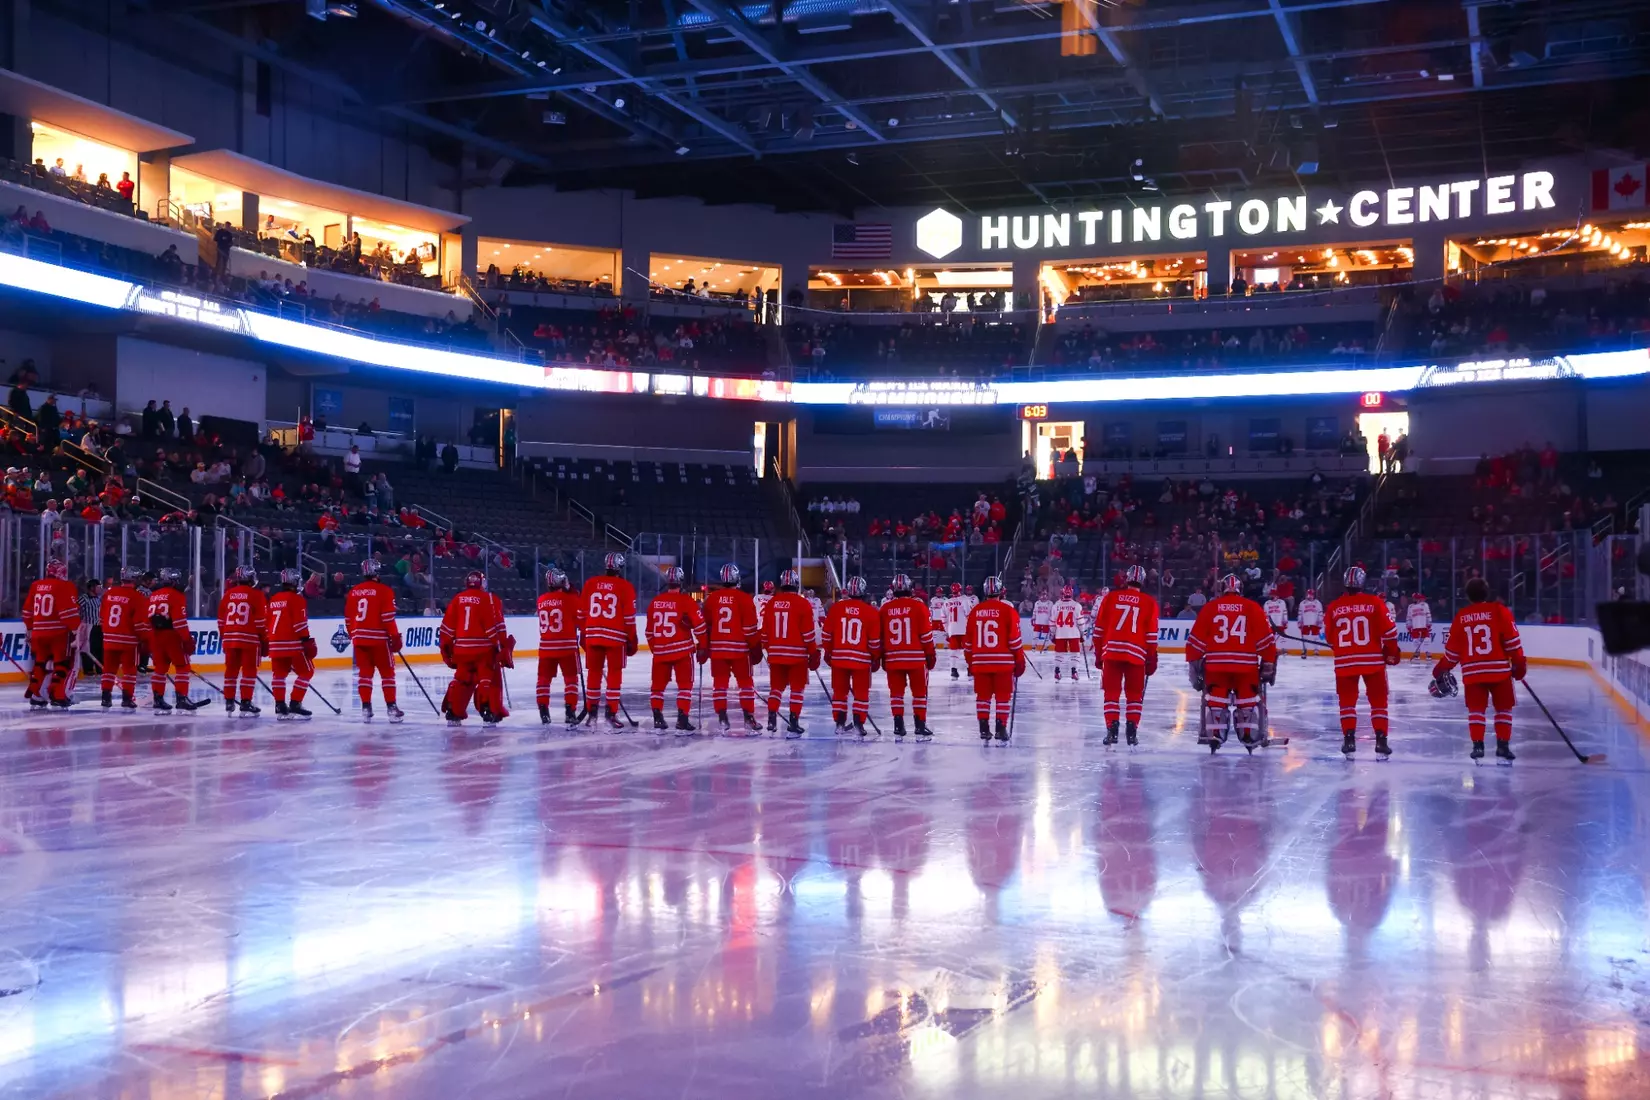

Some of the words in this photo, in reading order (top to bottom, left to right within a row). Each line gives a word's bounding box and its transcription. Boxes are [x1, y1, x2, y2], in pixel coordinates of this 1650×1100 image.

[982, 196, 1306, 249] HUNTINGTON
[1350, 171, 1555, 227] CENTER
[1024, 405, 1047, 418] 6:03
[597, 583, 614, 591] LEWIS
[34, 594, 54, 616] 60
[356, 598, 368, 622] 9
[590, 592, 617, 619] 63
[719, 596, 733, 604] ABLE
[845, 607, 860, 615] WEIS
[888, 607, 911, 616] DUNLAP
[1217, 604, 1243, 612] HERBST
[108, 604, 122, 628] 8
[226, 602, 250, 625] 29
[272, 610, 281, 634] 7
[464, 606, 471, 631] 1
[540, 608, 563, 634] 93
[653, 612, 678, 638] 25
[718, 607, 732, 633] 2
[774, 612, 789, 638] 11
[975, 609, 999, 618] MONTES
[1056, 611, 1074, 628] 44
[1115, 604, 1140, 633] 71
[1460, 611, 1493, 624] FONTAINE
[405, 627, 433, 648] OHIO
[841, 617, 863, 645] 10
[889, 617, 911, 645] 91
[976, 620, 999, 648] 16
[1213, 615, 1247, 644] 34
[1336, 616, 1370, 648] 20
[1463, 624, 1493, 656] 13
